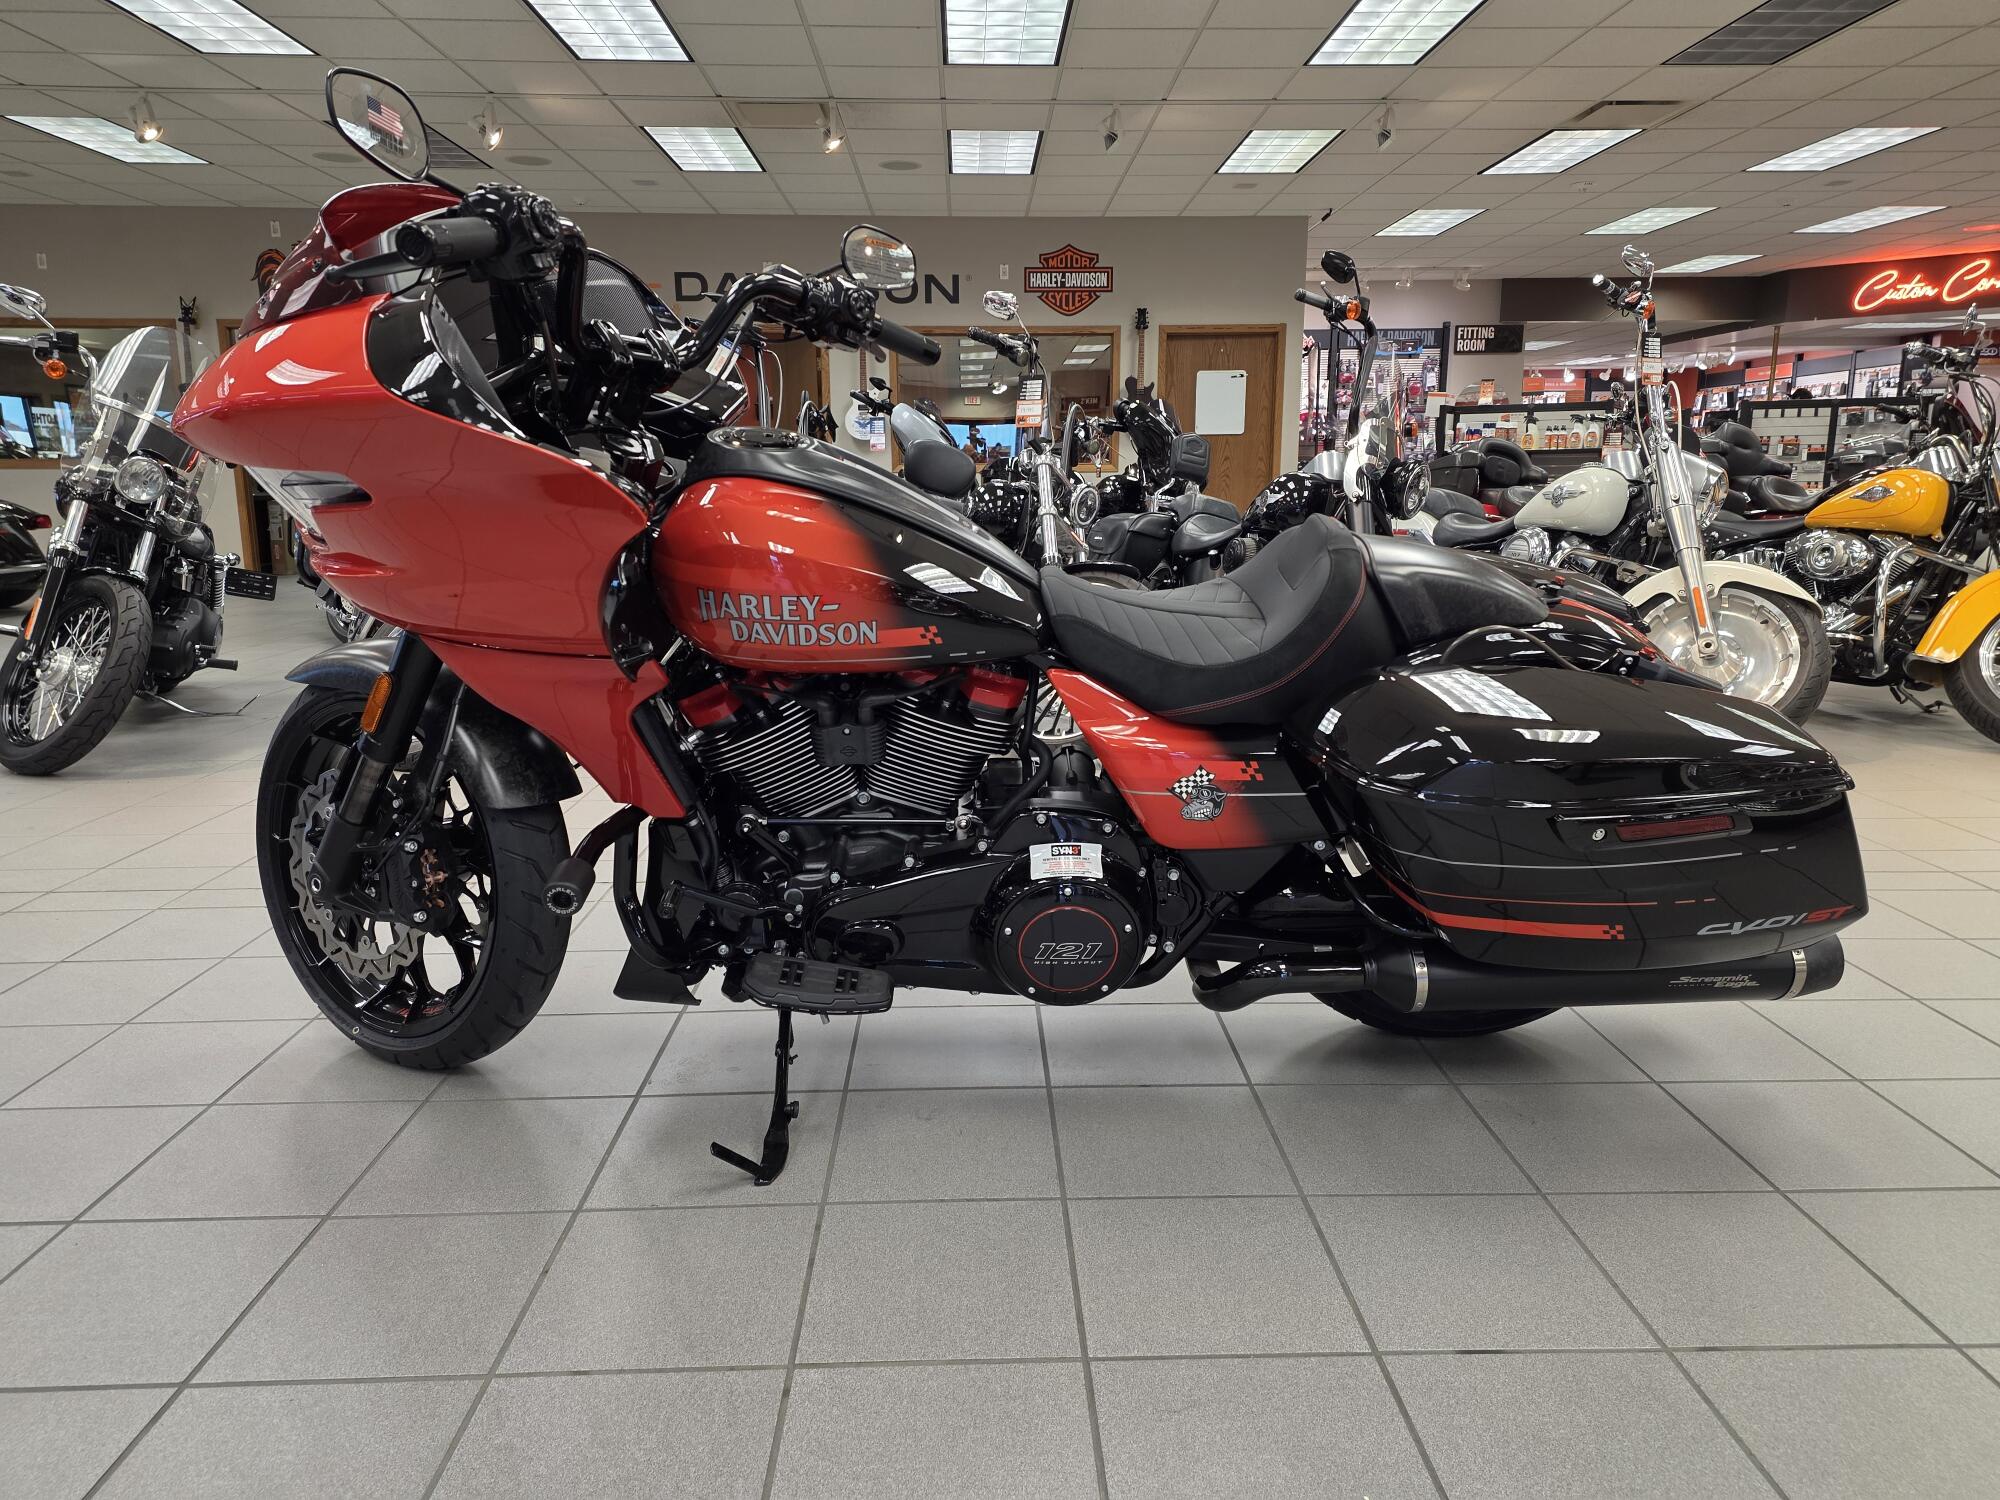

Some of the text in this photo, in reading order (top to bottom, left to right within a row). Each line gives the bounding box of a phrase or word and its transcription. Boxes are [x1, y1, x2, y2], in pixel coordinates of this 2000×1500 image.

[1049, 251, 1090, 268] MOTOR
[1030, 272, 1108, 288] HARLEY-DAVIDSON
[1854, 259, 2000, 311] Custom Cor
[1048, 291, 1090, 311] CYCLES
[1457, 326, 1495, 339] FITTING
[1456, 339, 1486, 352] ROOM
[697, 588, 840, 622] HARLEY-
[729, 619, 878, 647] DAVIDSON
[1034, 942, 1103, 960] 121
[1713, 980, 1761, 989] Eagle
